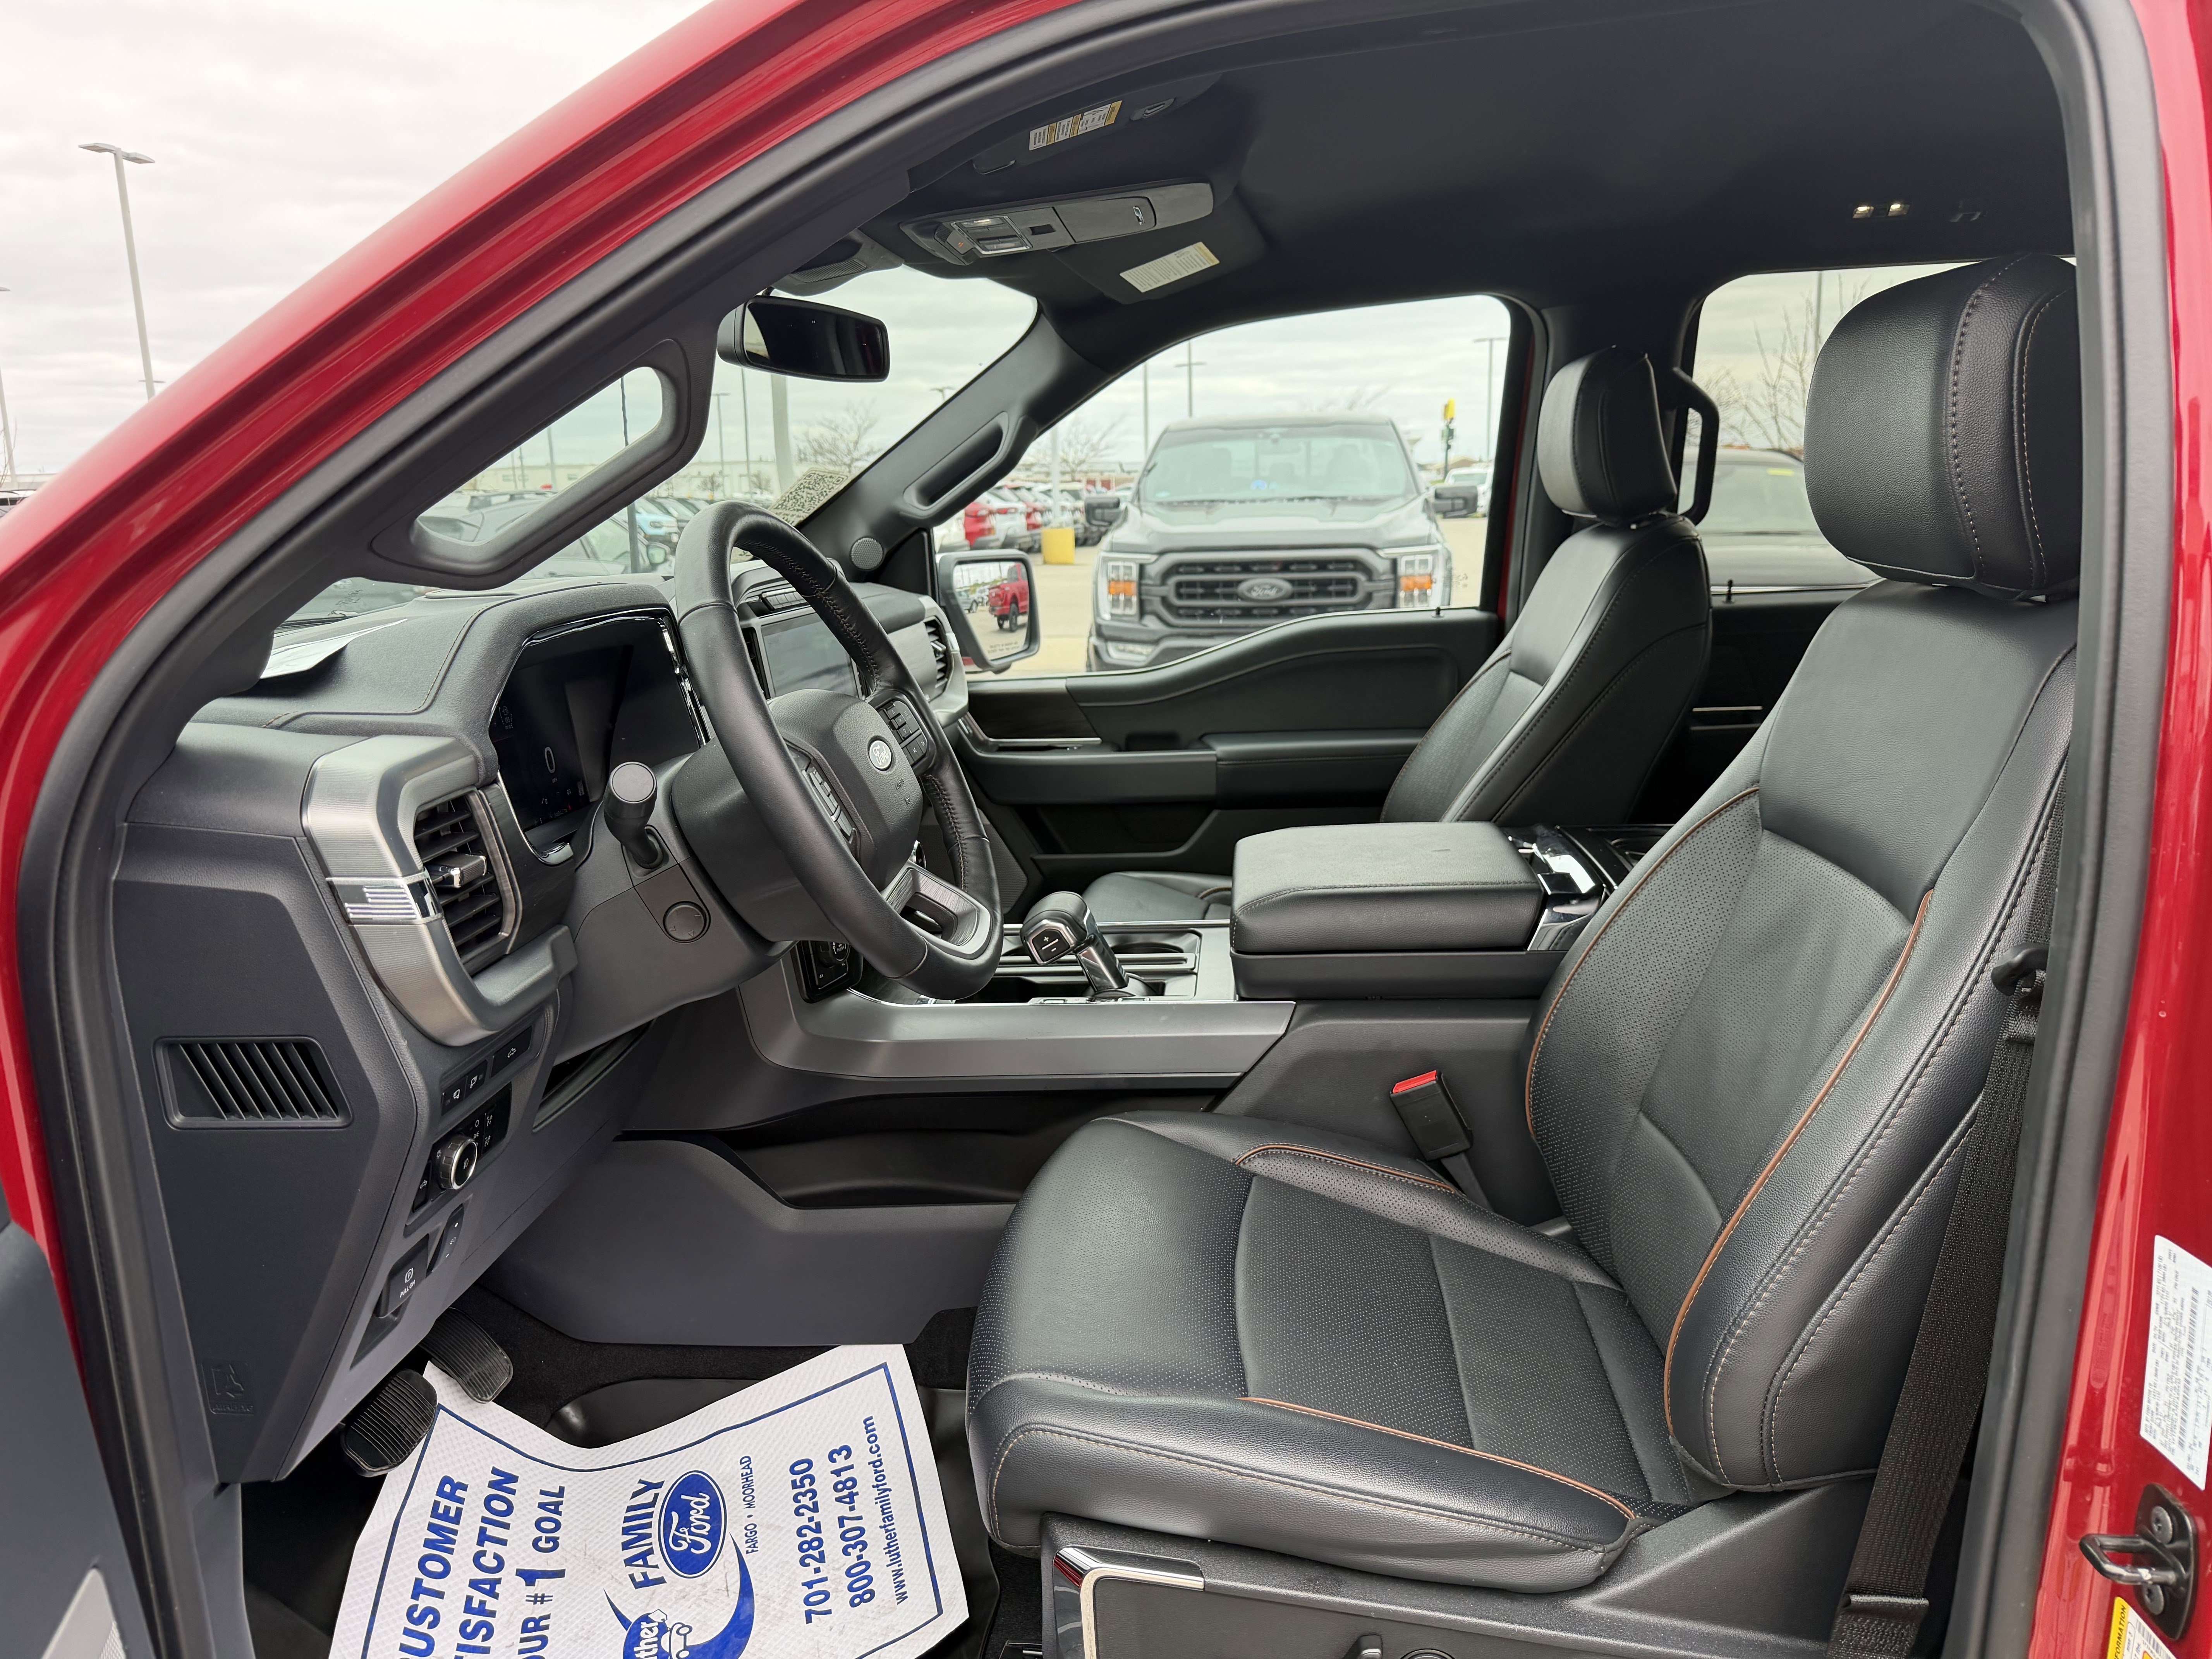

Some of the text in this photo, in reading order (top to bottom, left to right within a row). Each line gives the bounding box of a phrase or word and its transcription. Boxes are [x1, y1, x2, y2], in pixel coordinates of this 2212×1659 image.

[544, 747, 555, 773] 0
[409, 1279, 415, 1289] ON
[532, 1486, 565, 1553] GOAL
[621, 1479, 667, 1590] FAMILY
[669, 1492, 712, 1554] Ford
[740, 1455, 759, 1554] FARGO MOORHEAD
[789, 1458, 832, 1624] 701-282-2350
[828, 1444, 876, 1608] 800-307-4813
[863, 1415, 908, 1605] www.lutherfamilyford.com
[398, 1475, 469, 1659] USTOMER
[454, 1466, 519, 1659] ISFACTION
[518, 1613, 551, 1659] UR
[634, 1622, 659, 1659] ther
[2114, 1604, 2127, 1659] FORMATION
